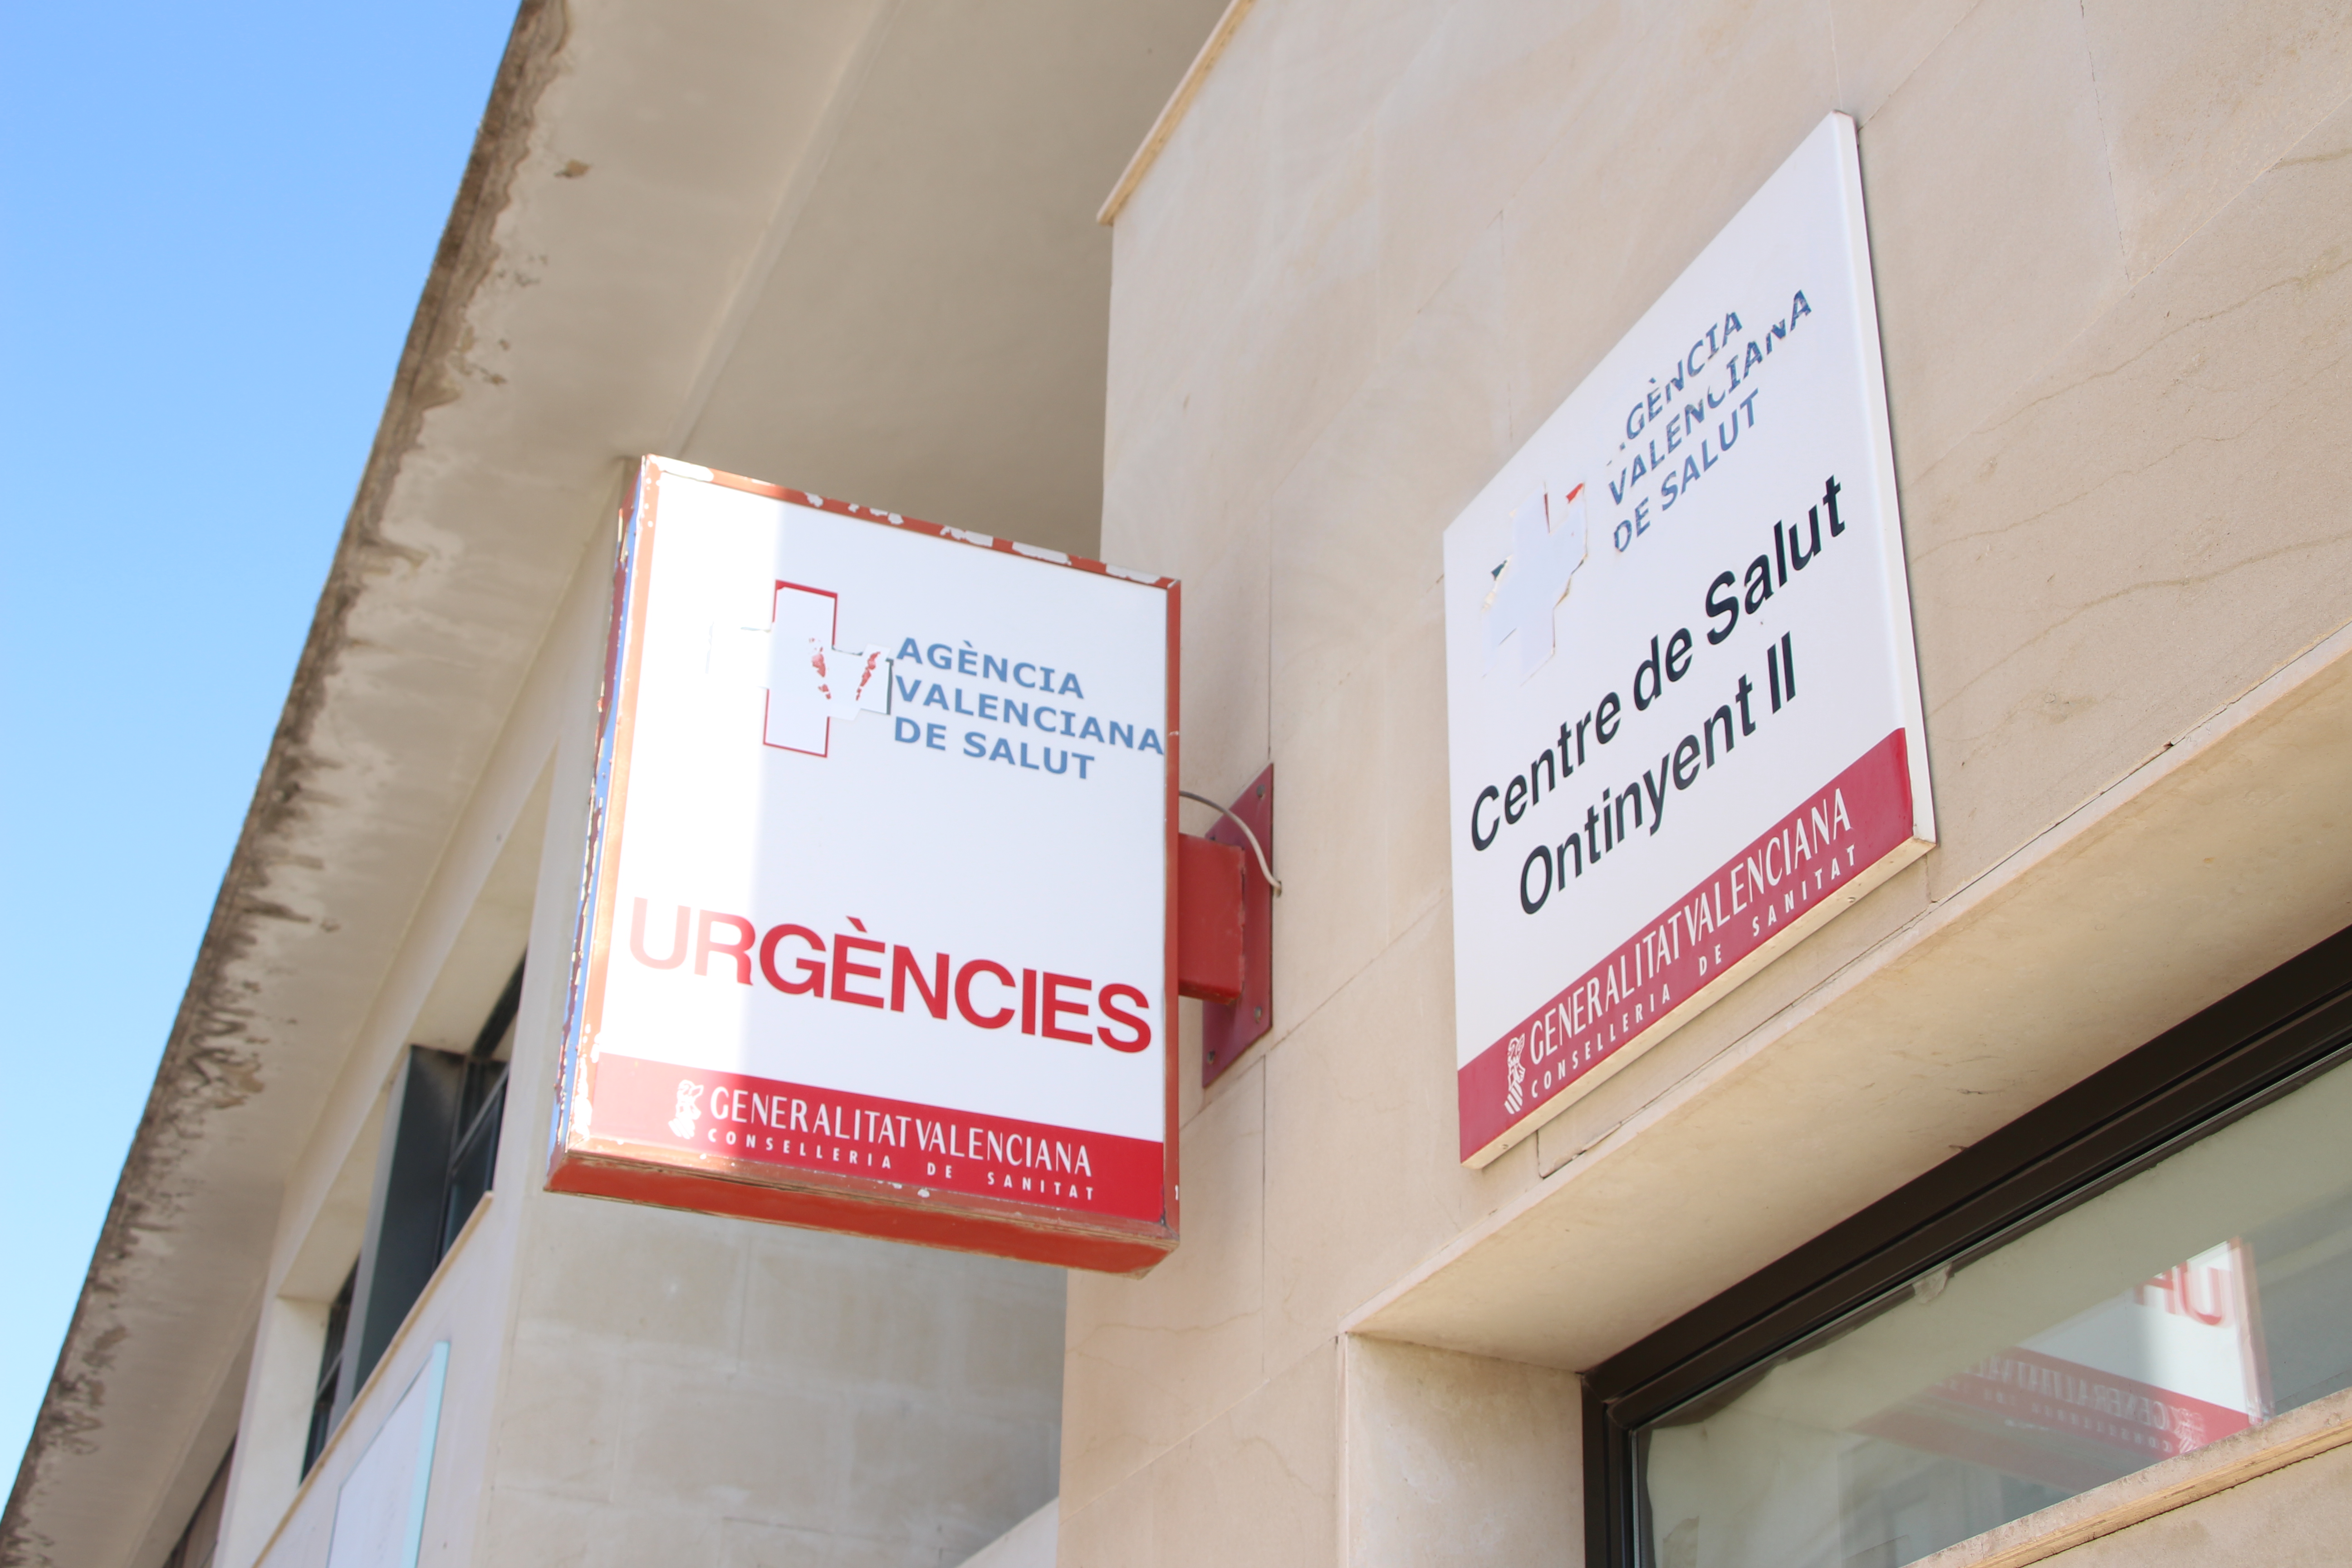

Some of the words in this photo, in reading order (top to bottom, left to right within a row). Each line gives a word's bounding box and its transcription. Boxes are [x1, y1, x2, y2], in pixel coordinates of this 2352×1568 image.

[1606, 312, 1742, 466] GÈNCIA
[1614, 497, 1651, 552] DE
[1661, 387, 1758, 511] SALUT
[895, 675, 1164, 755] VALENCIANA
[897, 637, 1084, 699] AGÈNCIA
[1471, 692, 1621, 851] Centre
[1633, 627, 1693, 710] de
[1705, 475, 1845, 645] Salut
[895, 716, 946, 751] DE
[963, 731, 1095, 779] SALUT
[1520, 673, 1756, 915] Ontinyent
[1767, 631, 1796, 714] II
[629, 897, 1152, 1054] URGÈNCIES
[1532, 984, 1670, 1098] CONSELLERIA
[1699, 944, 1722, 976] DE
[1752, 844, 1854, 936] SANITAT
[708, 1128, 891, 1169] CONSELLERIA
[927, 1162, 952, 1178] DE
[987, 1172, 1093, 1200] SANITAT
